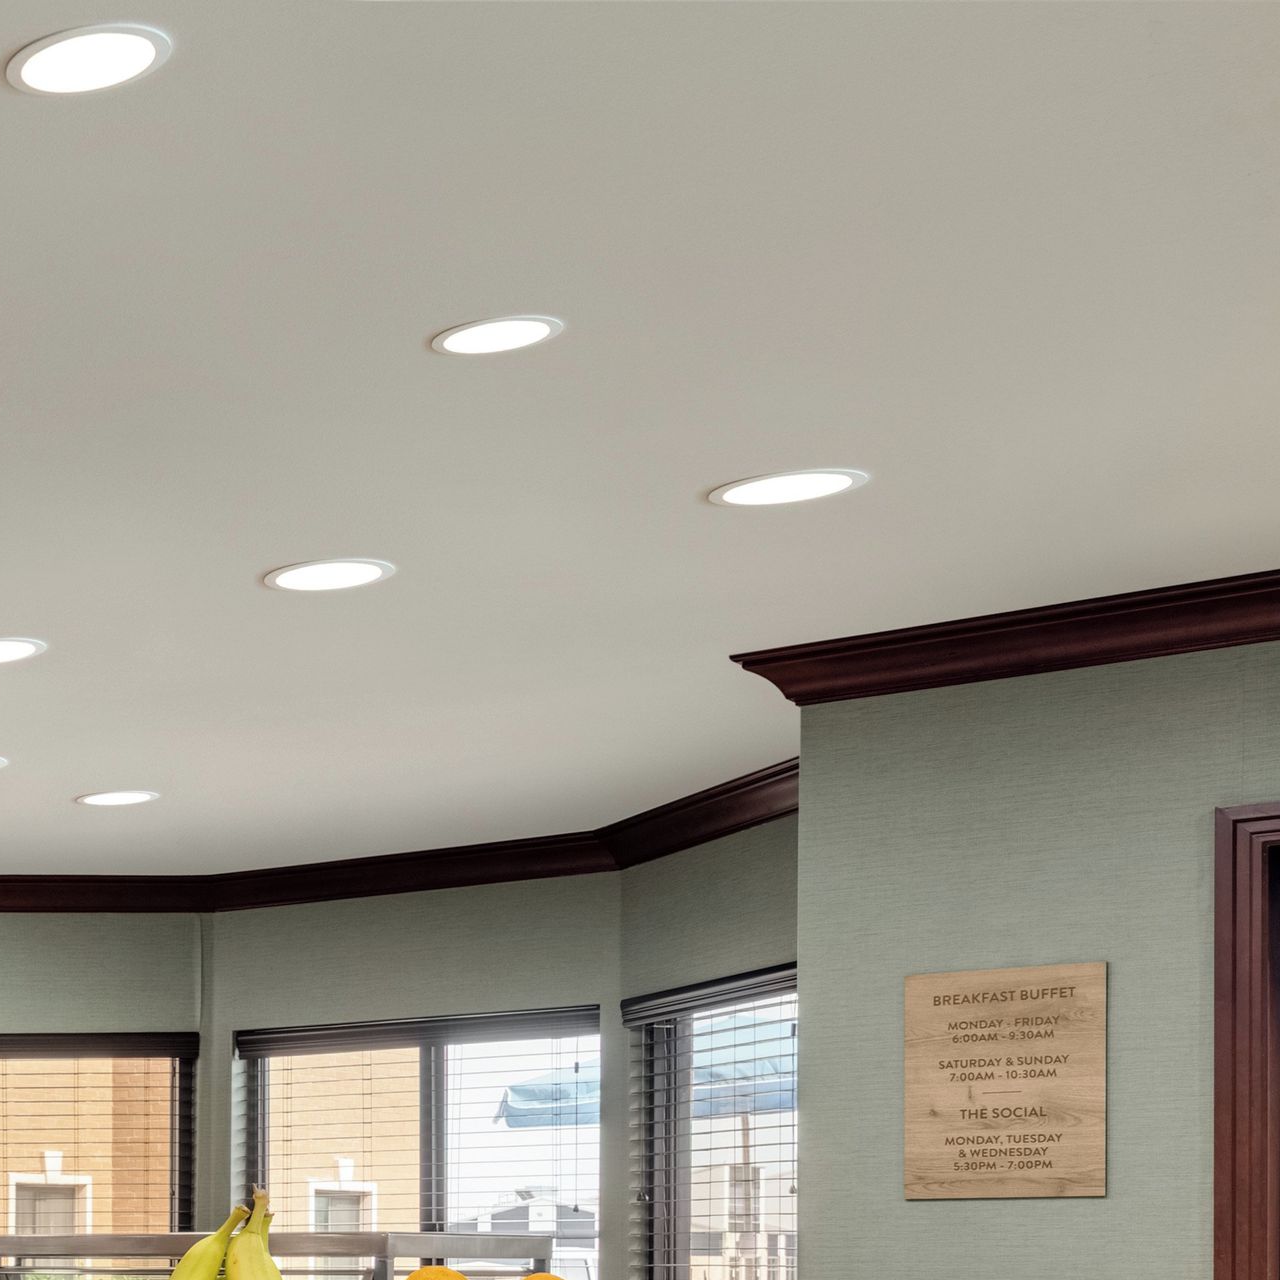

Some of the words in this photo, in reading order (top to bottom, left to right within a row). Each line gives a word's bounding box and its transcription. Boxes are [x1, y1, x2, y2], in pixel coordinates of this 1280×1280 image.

[933, 990, 1017, 1006] BREAKFAST
[1020, 986, 1076, 1001] BUFFET
[947, 1019, 1004, 1031] MONDAY
[1014, 1015, 1060, 1027] FRIDAY
[952, 1033, 998, 1043] 6:00AM
[1008, 1029, 1055, 1040] 9:30AM
[938, 1057, 1002, 1070] SATURDAY
[1005, 1056, 1014, 1066] &
[1017, 1054, 1070, 1066] SUNDAY
[950, 1071, 995, 1082] 7:00AM
[1006, 1068, 1057, 1079] 10:30AM
[960, 1108, 988, 1119] THE
[992, 1106, 1047, 1119] SOCIAL
[945, 1135, 1003, 1146] MONDAY,
[1006, 1133, 1063, 1144] TUESDAY
[958, 1149, 966, 1158] &
[970, 1146, 1049, 1158] WEDNESDAY
[953, 1161, 996, 1171] 5:30PM
[1007, 1160, 1053, 1170] 7:00PM
